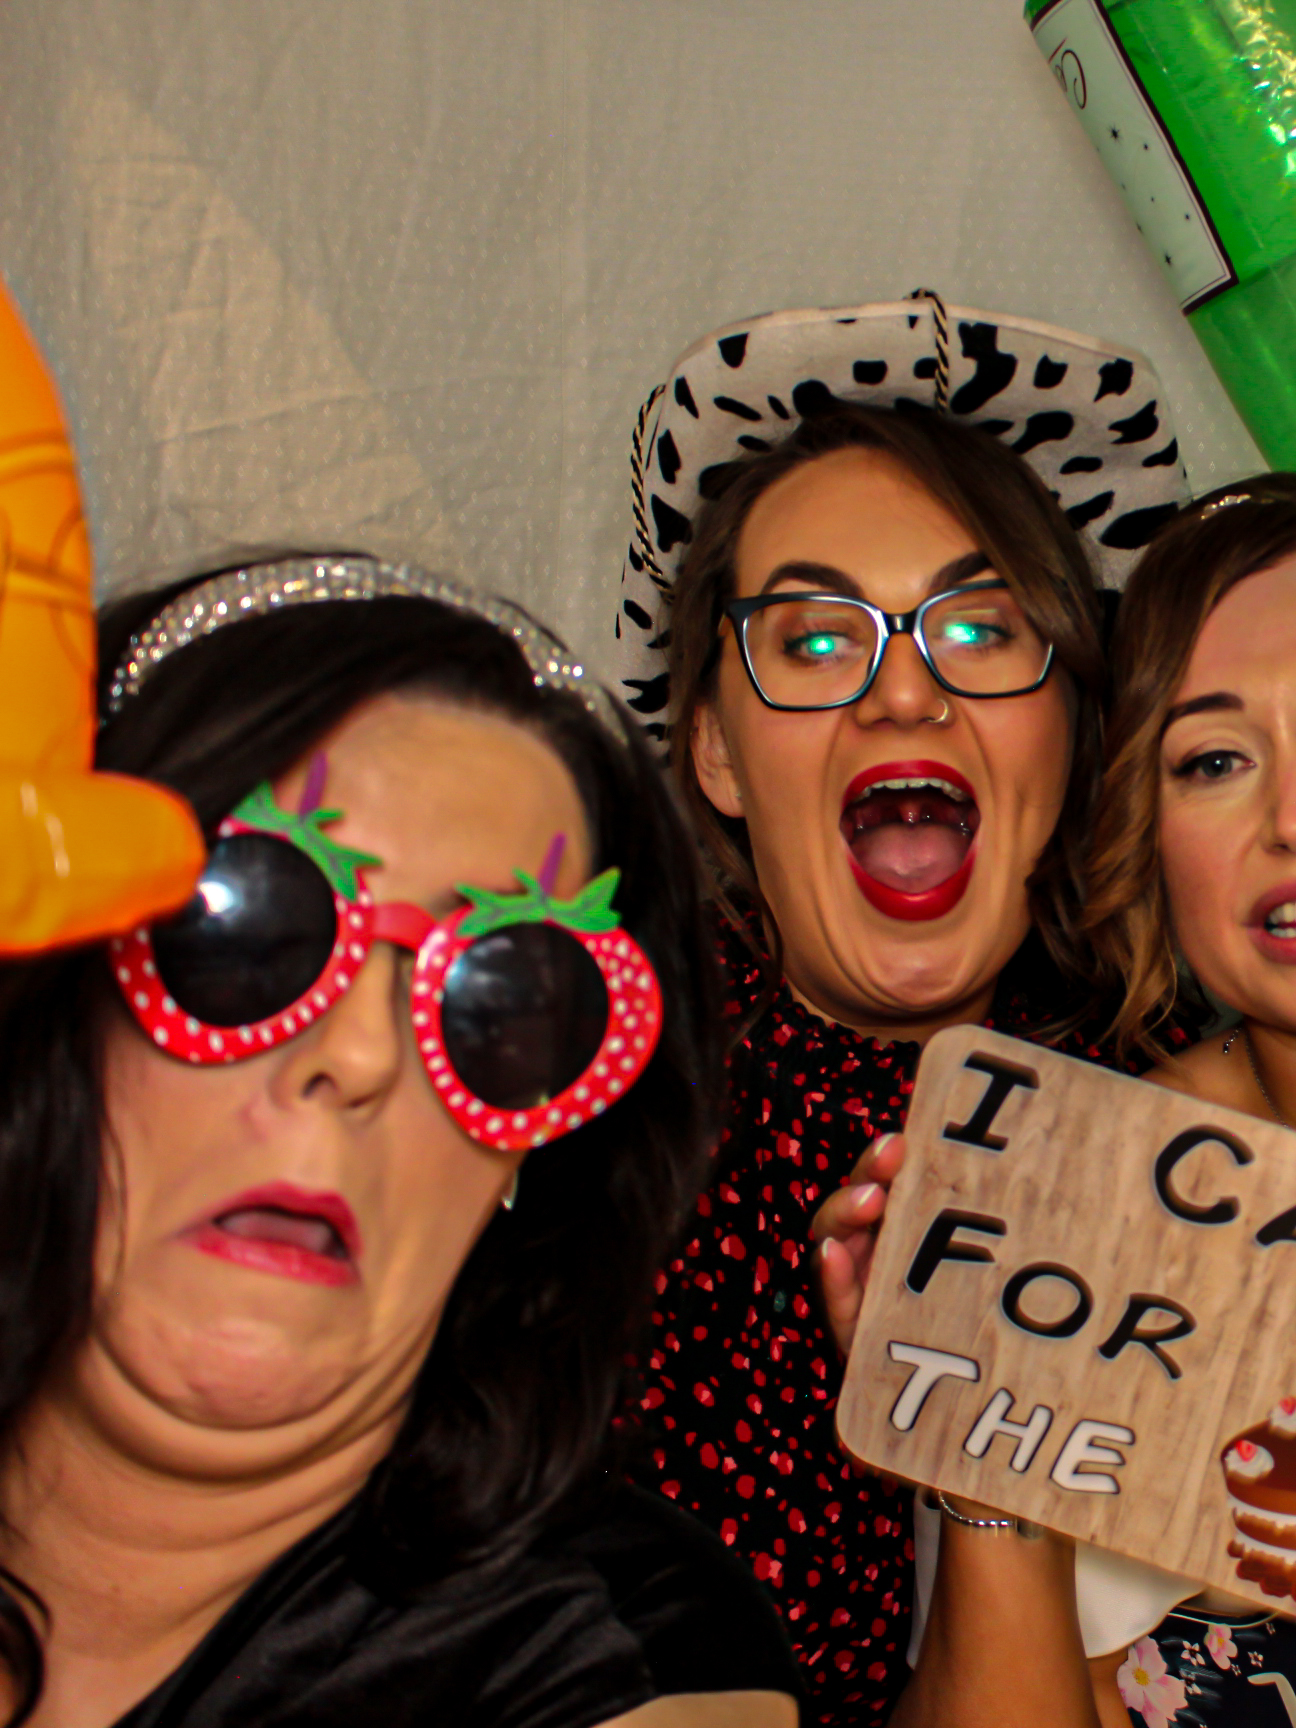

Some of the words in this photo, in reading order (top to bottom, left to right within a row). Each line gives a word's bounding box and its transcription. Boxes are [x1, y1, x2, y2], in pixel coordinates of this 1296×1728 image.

[943, 1052, 1039, 1151] I
[906, 1208, 1195, 1380] FOR
[888, 1341, 1136, 1495] THE
